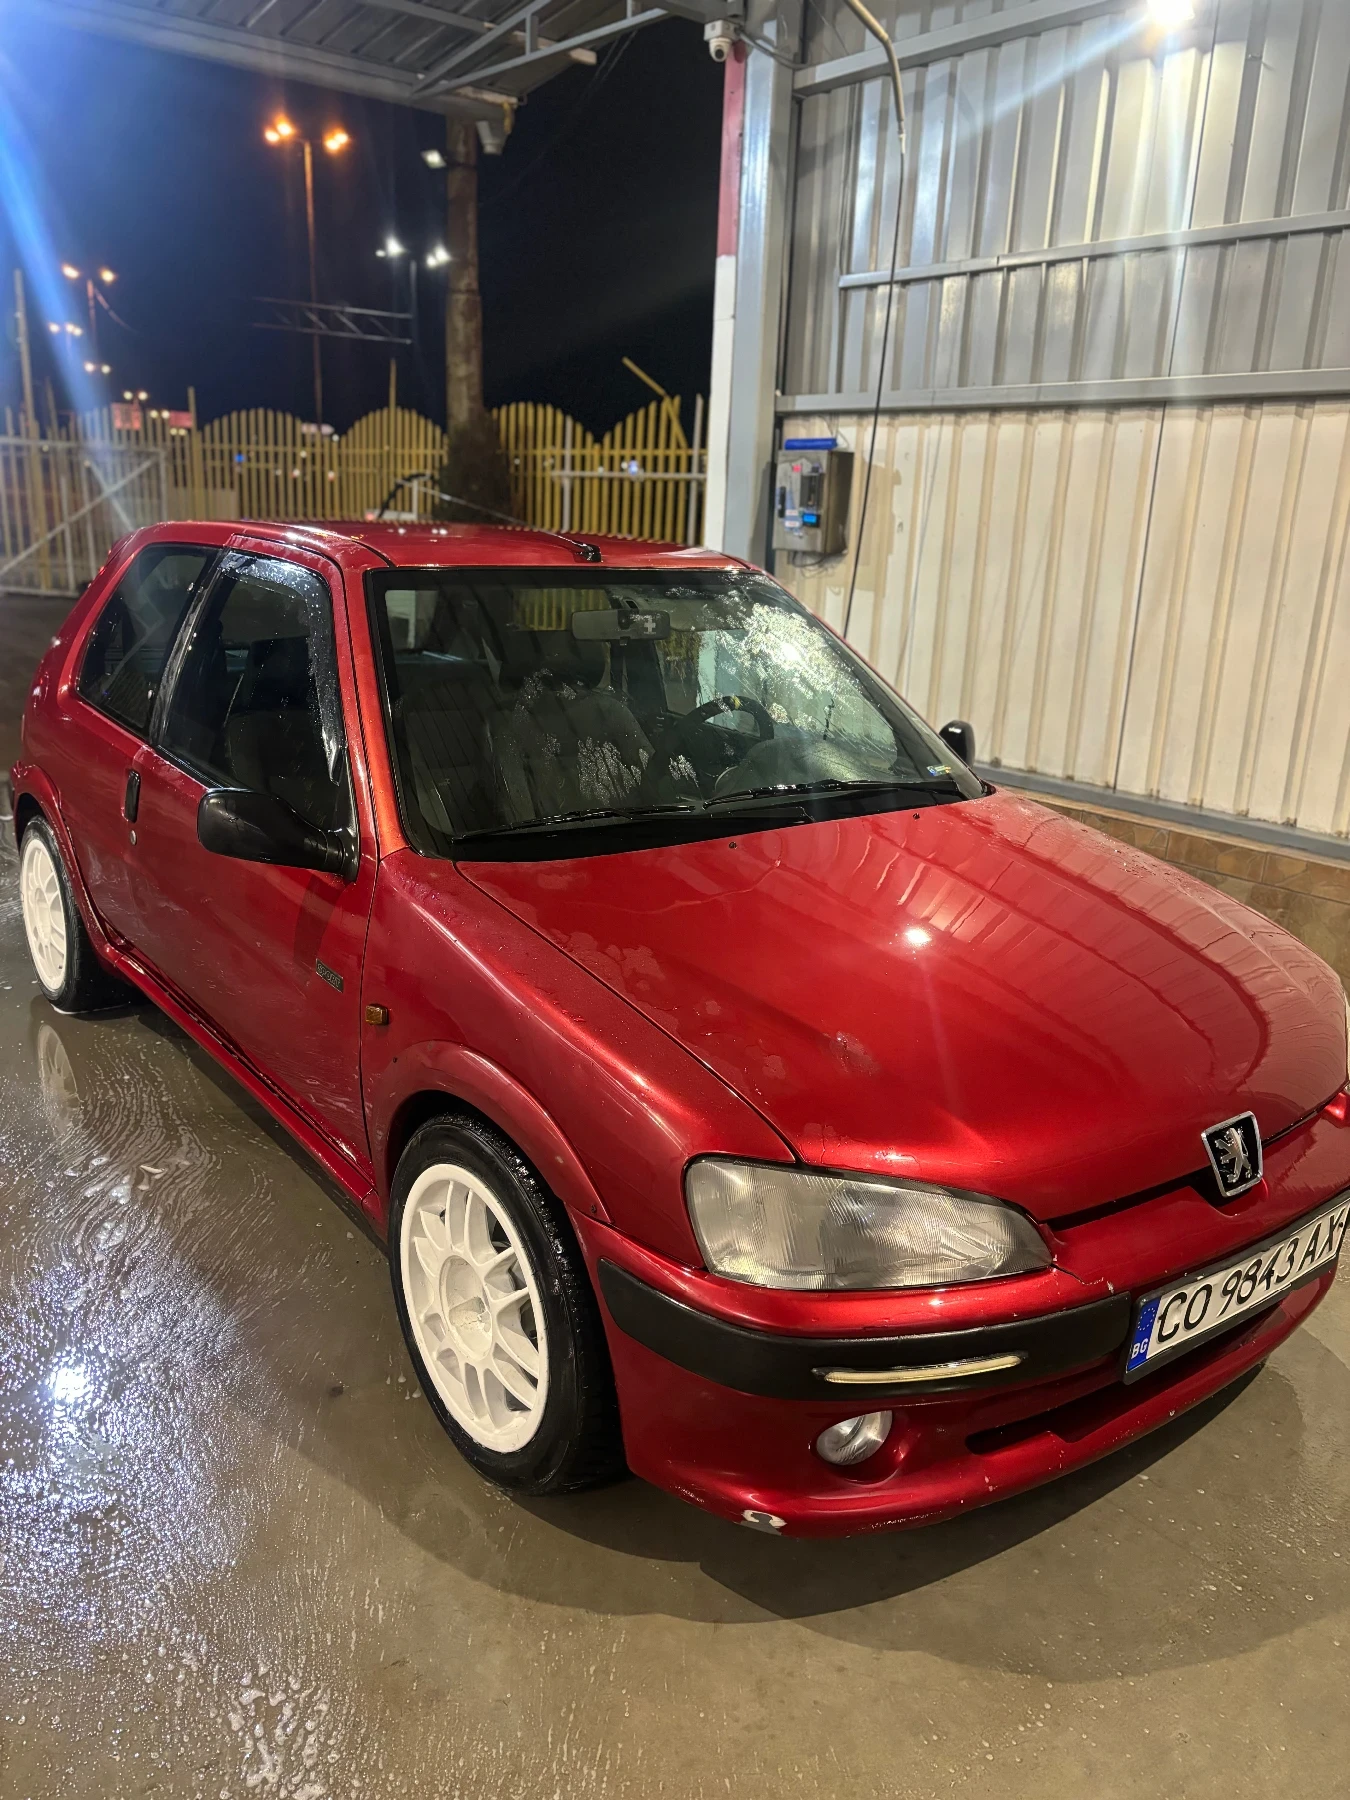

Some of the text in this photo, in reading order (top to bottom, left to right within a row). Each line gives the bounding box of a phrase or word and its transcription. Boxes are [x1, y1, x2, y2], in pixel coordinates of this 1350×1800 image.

[317, 963, 341, 988] SPORT
[1157, 1207, 1346, 1342] CO 9843 AX
[1131, 1338, 1149, 1359] BG
